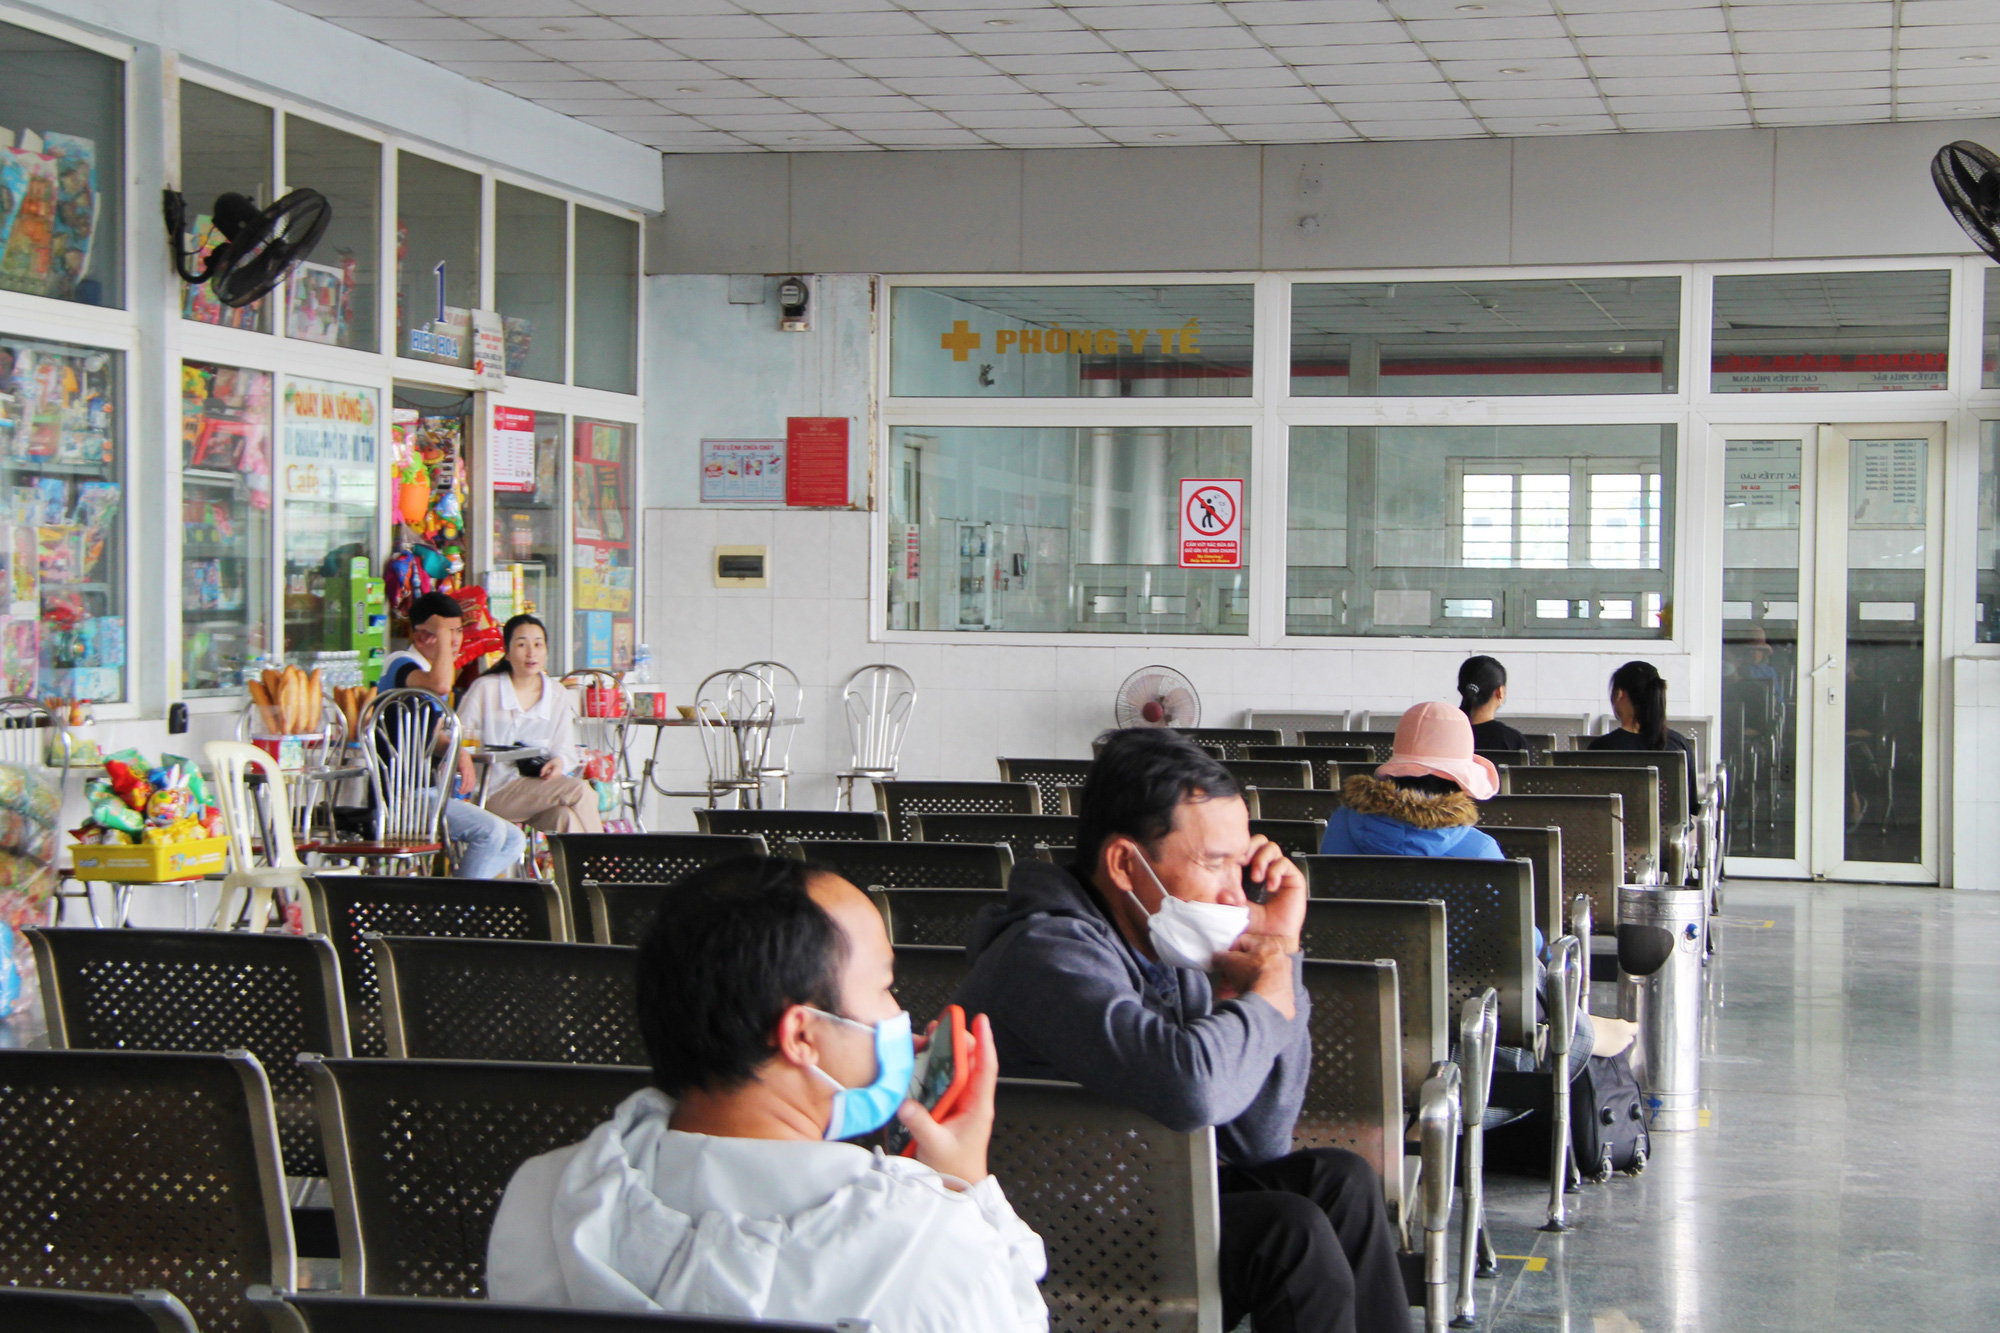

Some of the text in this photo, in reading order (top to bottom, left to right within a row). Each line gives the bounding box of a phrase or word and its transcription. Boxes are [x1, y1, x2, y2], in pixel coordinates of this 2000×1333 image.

[433, 260, 447, 324] 1
[437, 334, 459, 359] HOA
[996, 317, 1200, 354] PHÒNG Y TẾ
